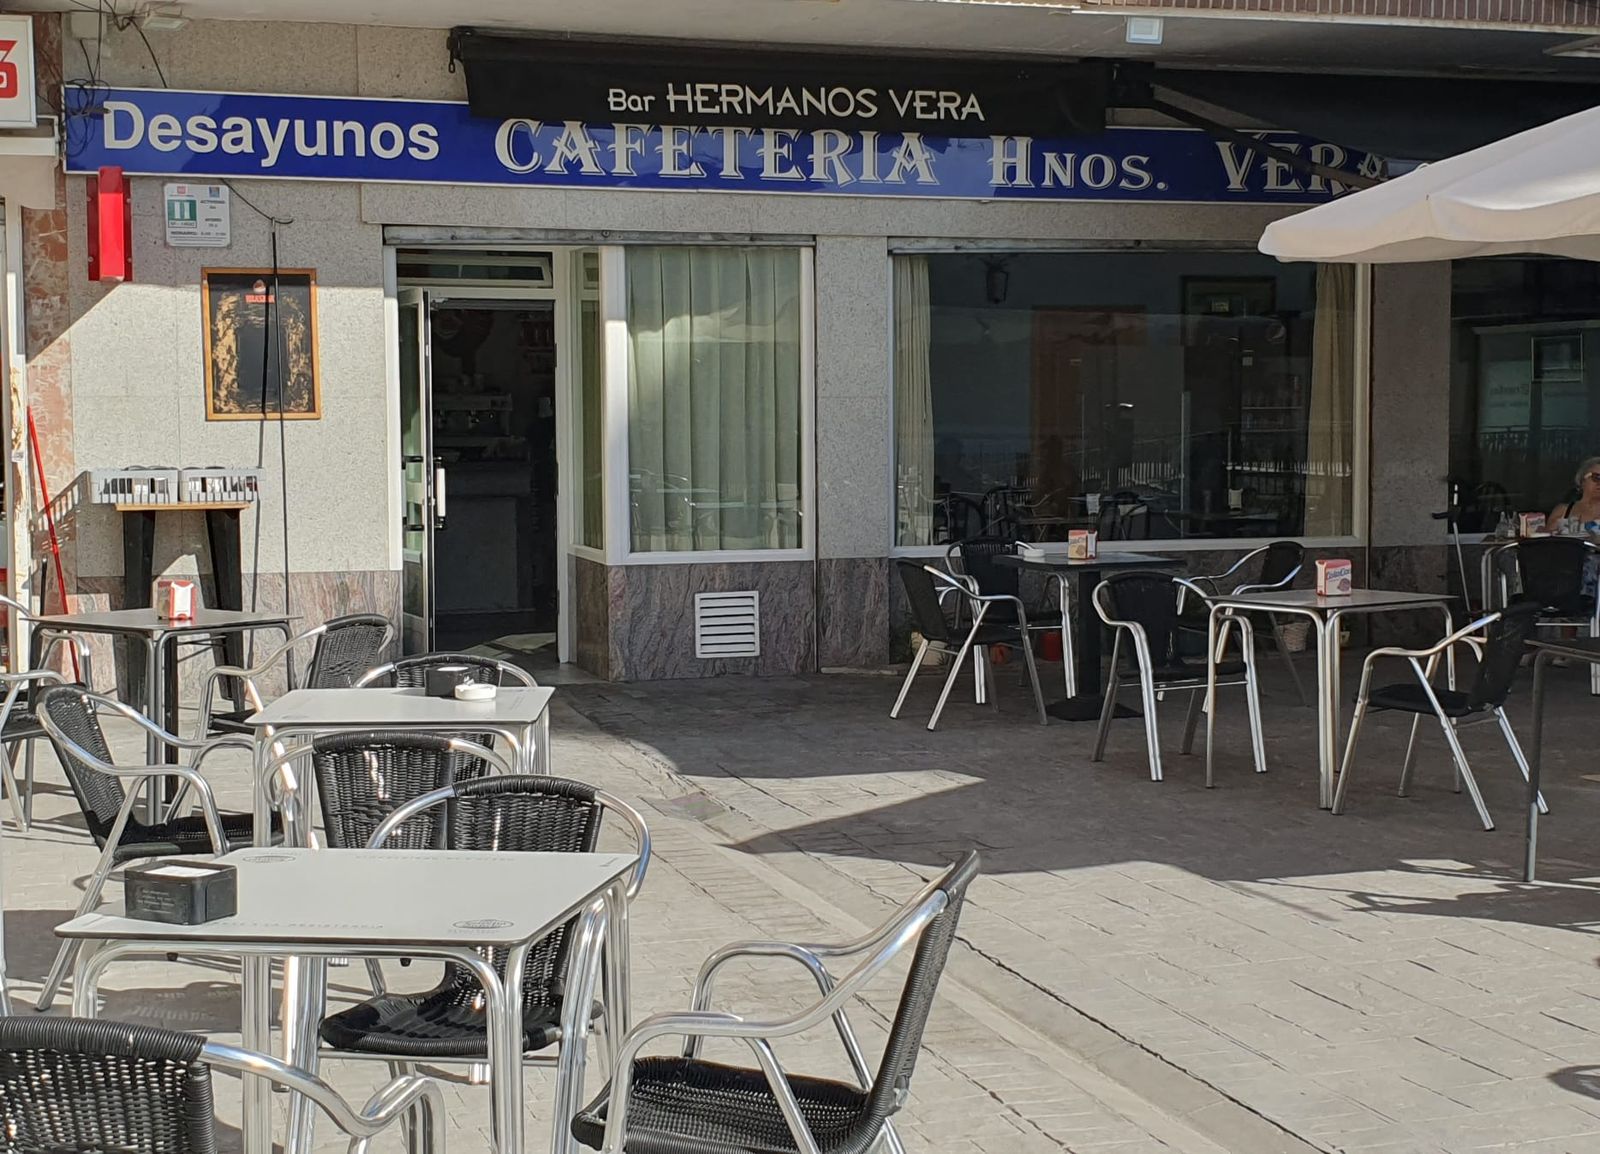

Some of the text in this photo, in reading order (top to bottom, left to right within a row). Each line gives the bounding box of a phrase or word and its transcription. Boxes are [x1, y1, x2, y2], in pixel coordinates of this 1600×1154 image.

[103, 100, 440, 167] Desayunos
[608, 82, 985, 122] Bar HERMANOS VERA
[495, 117, 940, 187] CAFETERIA
